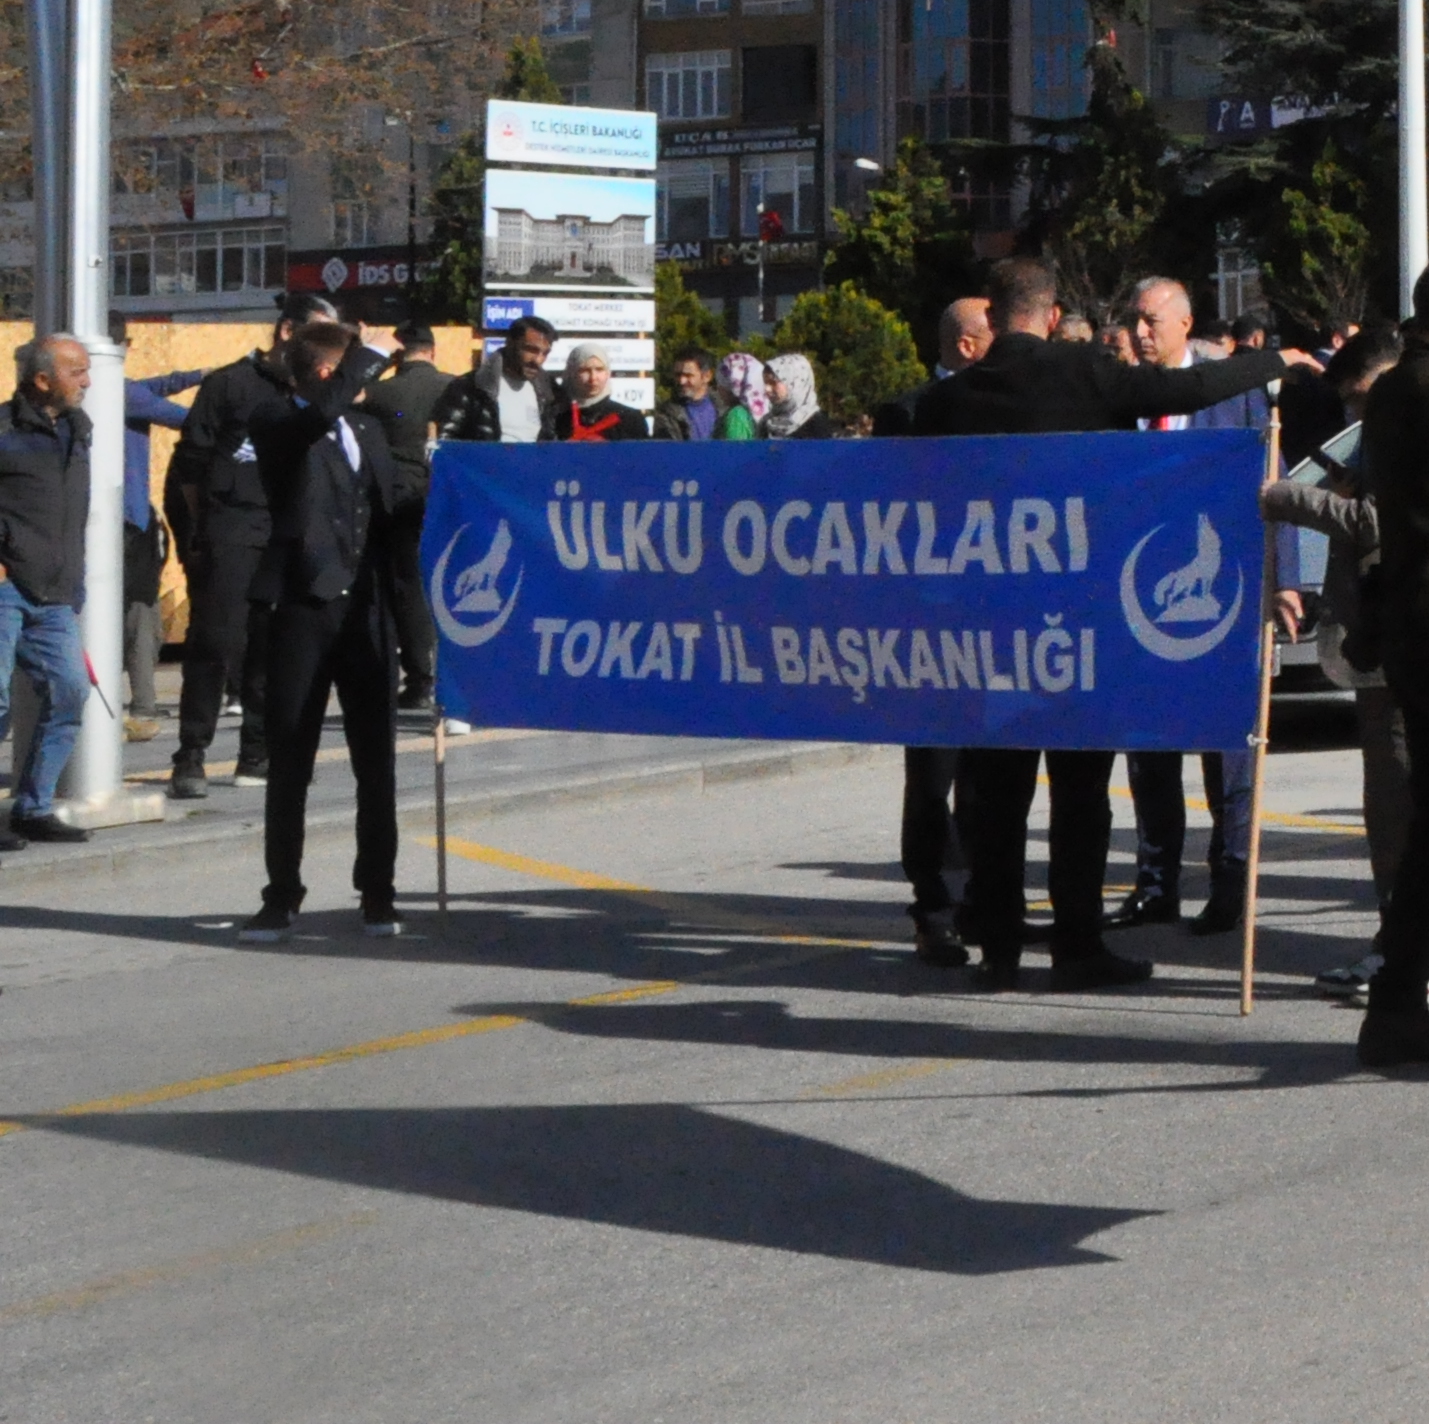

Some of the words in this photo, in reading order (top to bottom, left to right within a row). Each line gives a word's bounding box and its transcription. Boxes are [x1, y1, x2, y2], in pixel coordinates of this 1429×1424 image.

[624, 389, 645, 403] KDV
[547, 480, 704, 574] ÜLKÜ
[723, 496, 1089, 576] OCAKLARI
[533, 618, 702, 679] TOKAT
[715, 610, 763, 684] İL
[772, 612, 1096, 704] BAŞKANLIĞI
